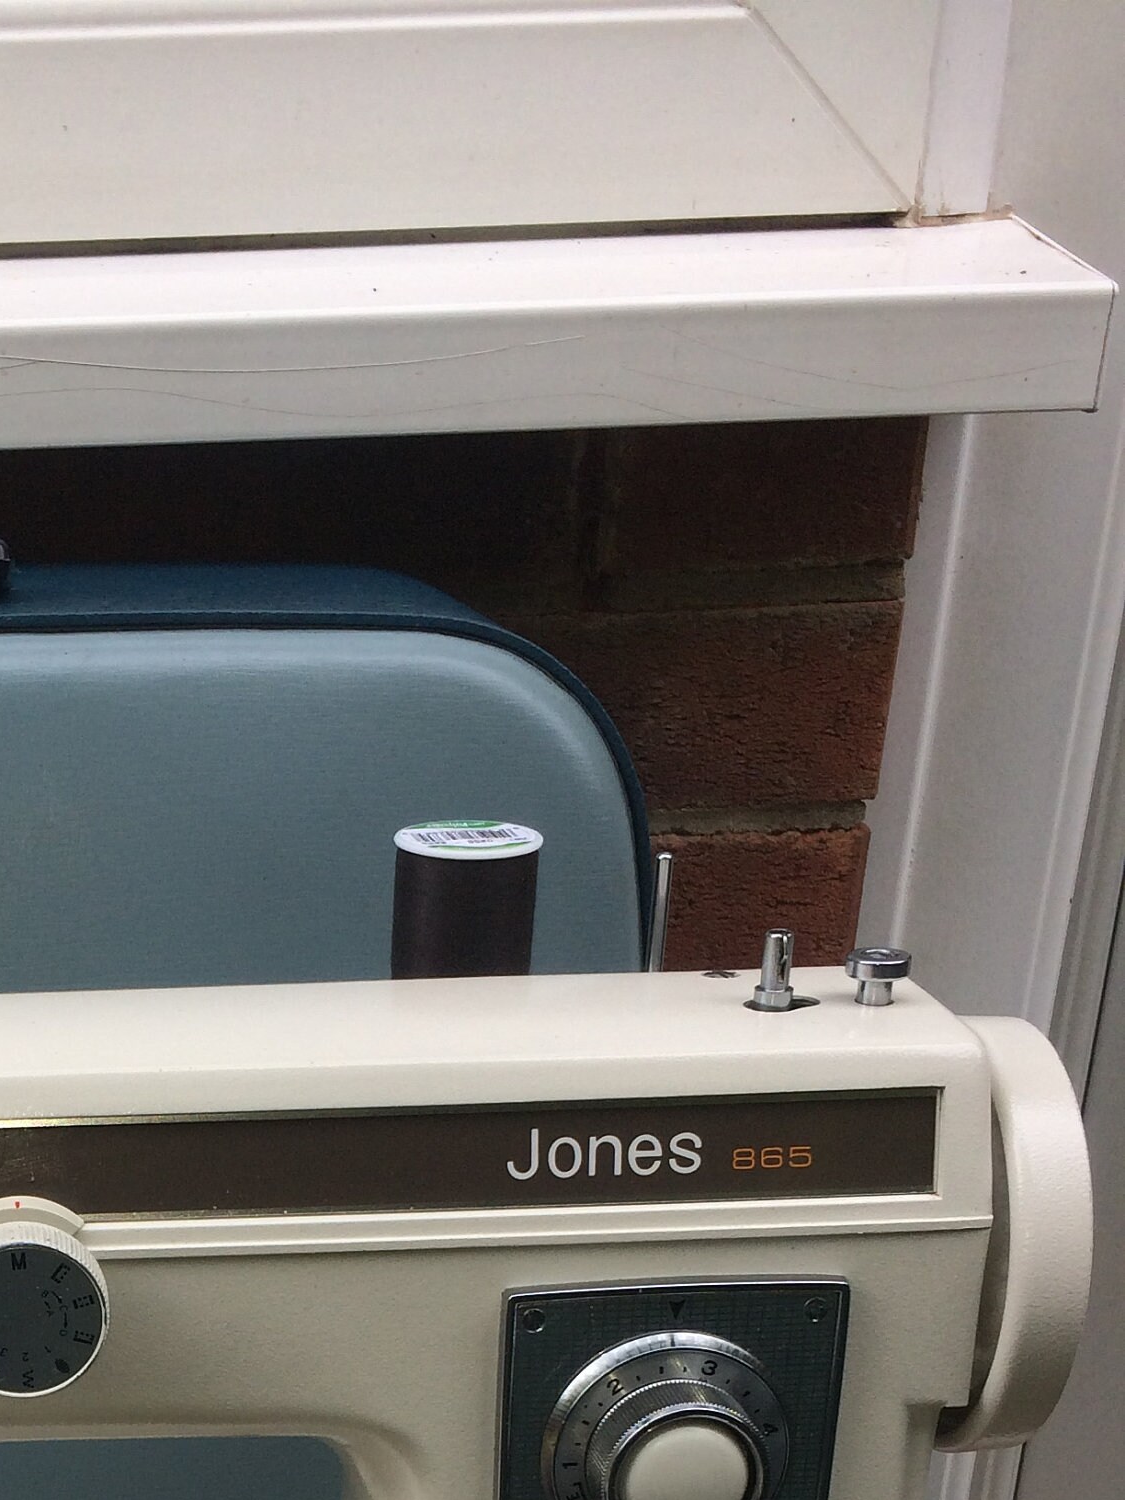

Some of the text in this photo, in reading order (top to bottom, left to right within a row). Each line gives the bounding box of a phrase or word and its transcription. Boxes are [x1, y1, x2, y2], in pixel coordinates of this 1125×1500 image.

[506, 1128, 812, 1180] Jones 865
[11, 1252, 27, 1271] M
[701, 1360, 718, 1375] 3
[606, 1379, 624, 1396] 2
[763, 1423, 778, 1434] 4
[562, 1461, 578, 1470] 1
